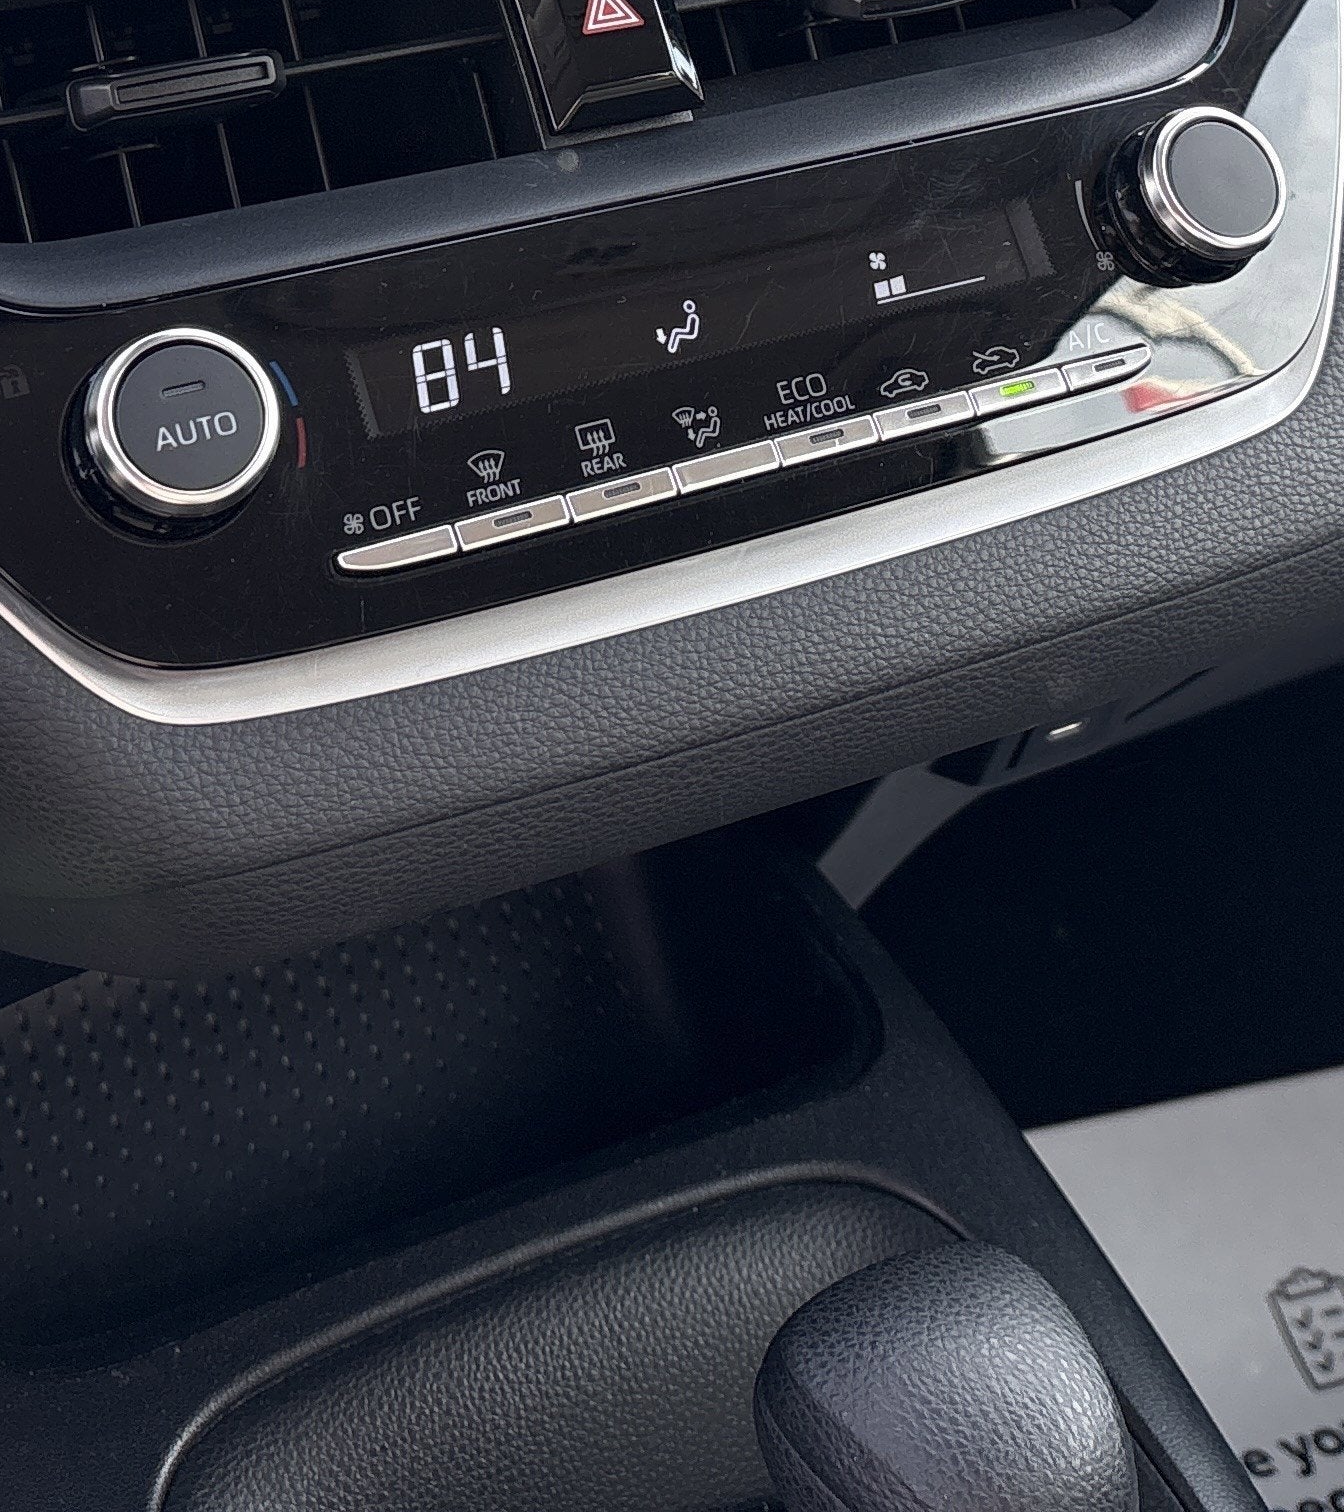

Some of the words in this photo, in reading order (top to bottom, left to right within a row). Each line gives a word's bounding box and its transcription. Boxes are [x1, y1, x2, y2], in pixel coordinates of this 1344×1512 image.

[1068, 322, 1110, 351] A/C
[411, 327, 511, 413] 84
[776, 373, 827, 404] ECO
[764, 396, 856, 432] HEAT/COOL
[155, 410, 237, 451] AUTO
[580, 452, 626, 476] REAR
[466, 479, 521, 507] FRONT
[369, 497, 421, 531] OFF
